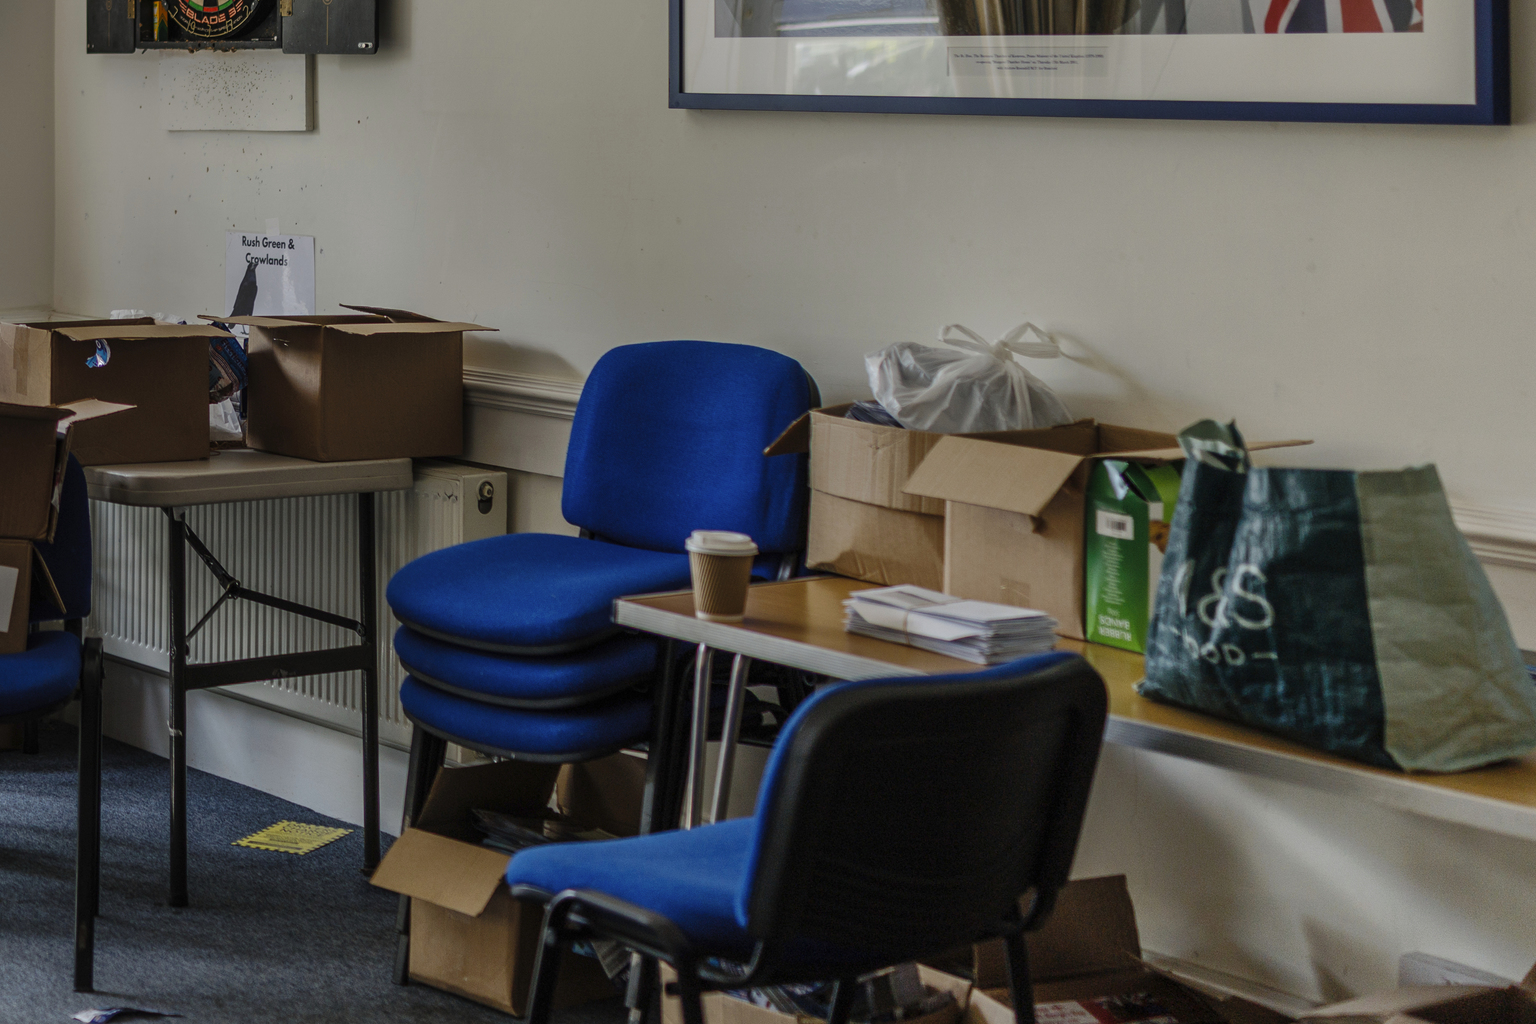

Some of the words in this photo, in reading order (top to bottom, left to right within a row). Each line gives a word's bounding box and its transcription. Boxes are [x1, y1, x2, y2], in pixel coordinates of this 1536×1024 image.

[185, 8, 227, 25] BLADE
[241, 236, 260, 248] Rush
[262, 237, 286, 249] Green
[287, 238, 295, 250] &
[245, 252, 288, 267] Crowlands
